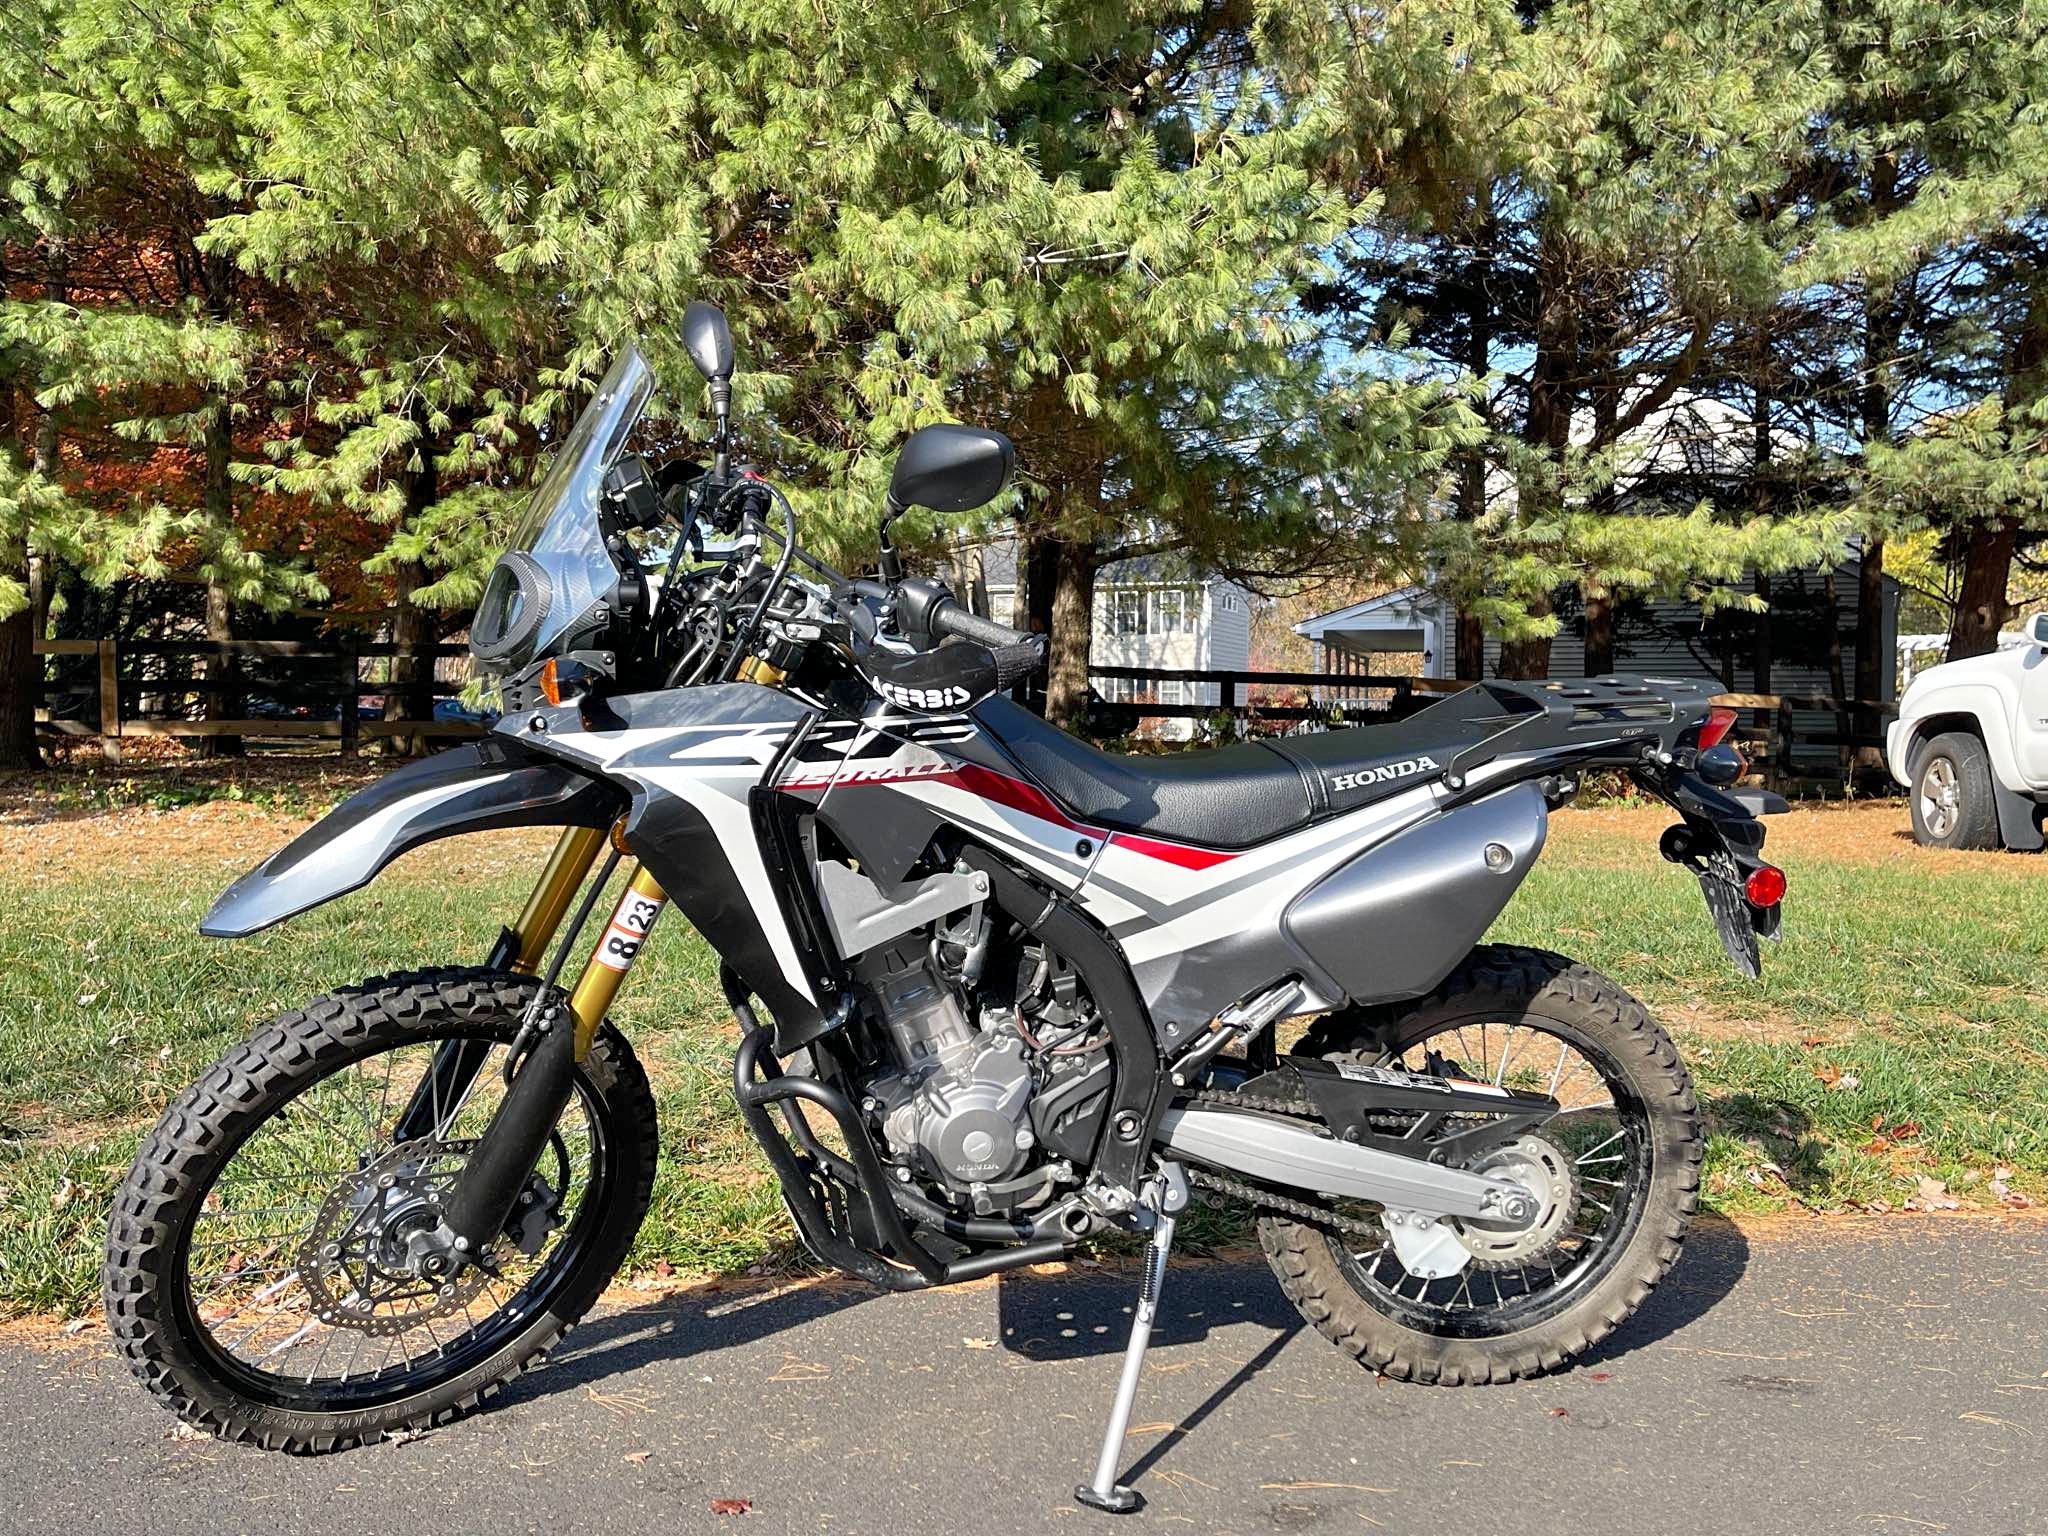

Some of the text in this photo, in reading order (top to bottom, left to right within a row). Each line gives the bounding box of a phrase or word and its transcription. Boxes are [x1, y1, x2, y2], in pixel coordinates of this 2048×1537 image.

[1331, 756, 1440, 791] HONDA
[607, 937, 640, 960] 8
[628, 901, 657, 931] 23
